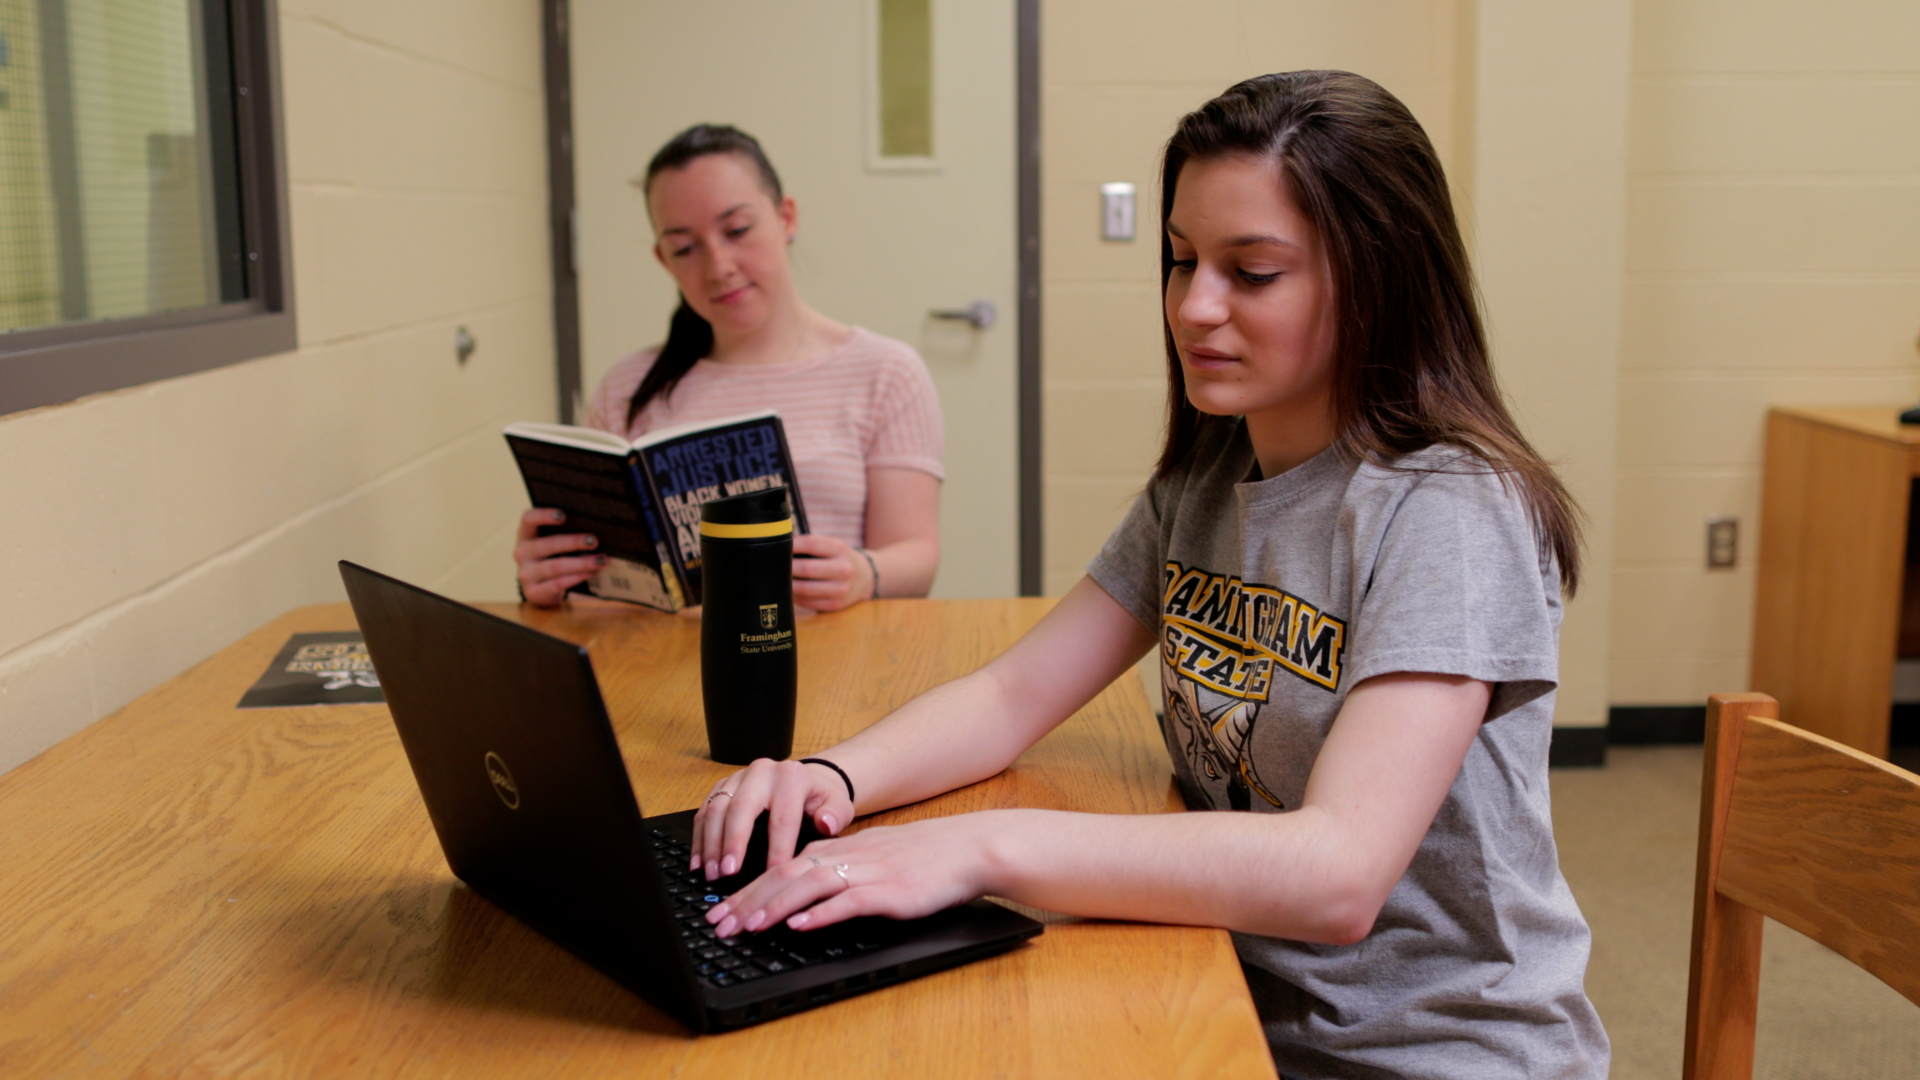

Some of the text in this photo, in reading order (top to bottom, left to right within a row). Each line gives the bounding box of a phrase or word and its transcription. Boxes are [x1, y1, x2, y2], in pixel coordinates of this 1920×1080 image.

[653, 424, 777, 475] ARRESTED
[661, 451, 785, 498] JUSTICE
[664, 485, 722, 512] BLACK
[740, 630, 792, 643] Framingham
[740, 642, 792, 654] State University
[1164, 622, 1273, 699] STATE
